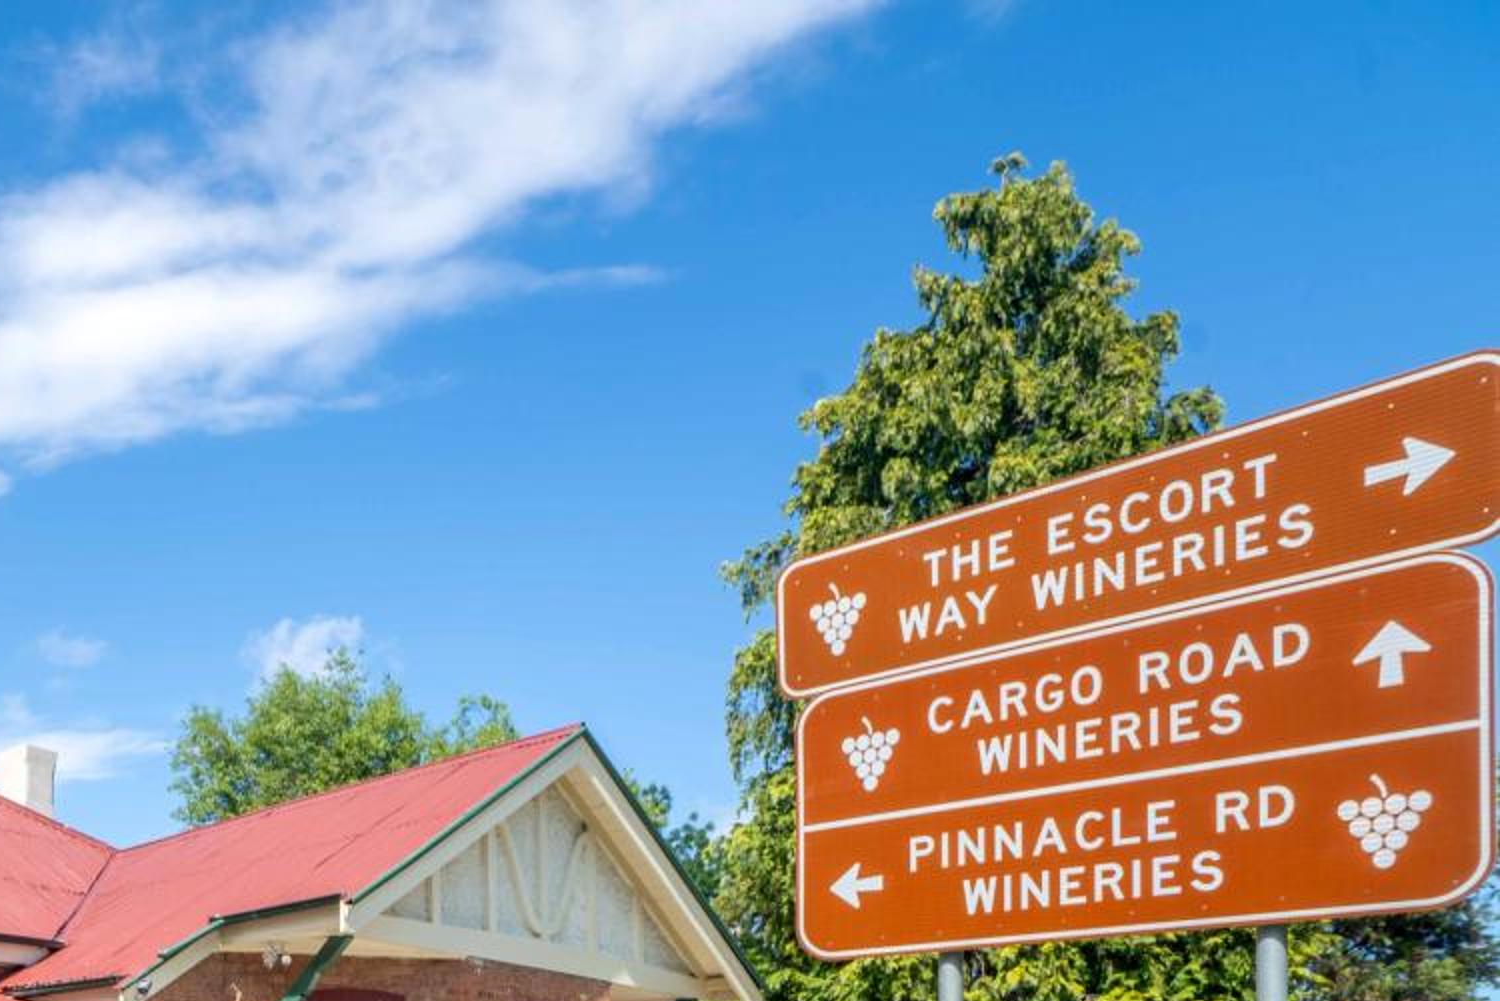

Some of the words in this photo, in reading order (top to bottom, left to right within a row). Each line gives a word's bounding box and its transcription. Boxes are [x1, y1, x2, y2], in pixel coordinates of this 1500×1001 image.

[923, 530, 1015, 587] THE
[1047, 454, 1277, 555] ESCORT
[899, 586, 996, 643] WAY
[1031, 503, 1314, 610] WINERIES
[927, 665, 1102, 734] CARGO
[1139, 623, 1310, 694] ROAD
[978, 693, 1242, 774] WINERIES
[909, 800, 1177, 872] PINNACLE
[1215, 785, 1295, 833] RD
[963, 851, 1223, 915] WINERIES
